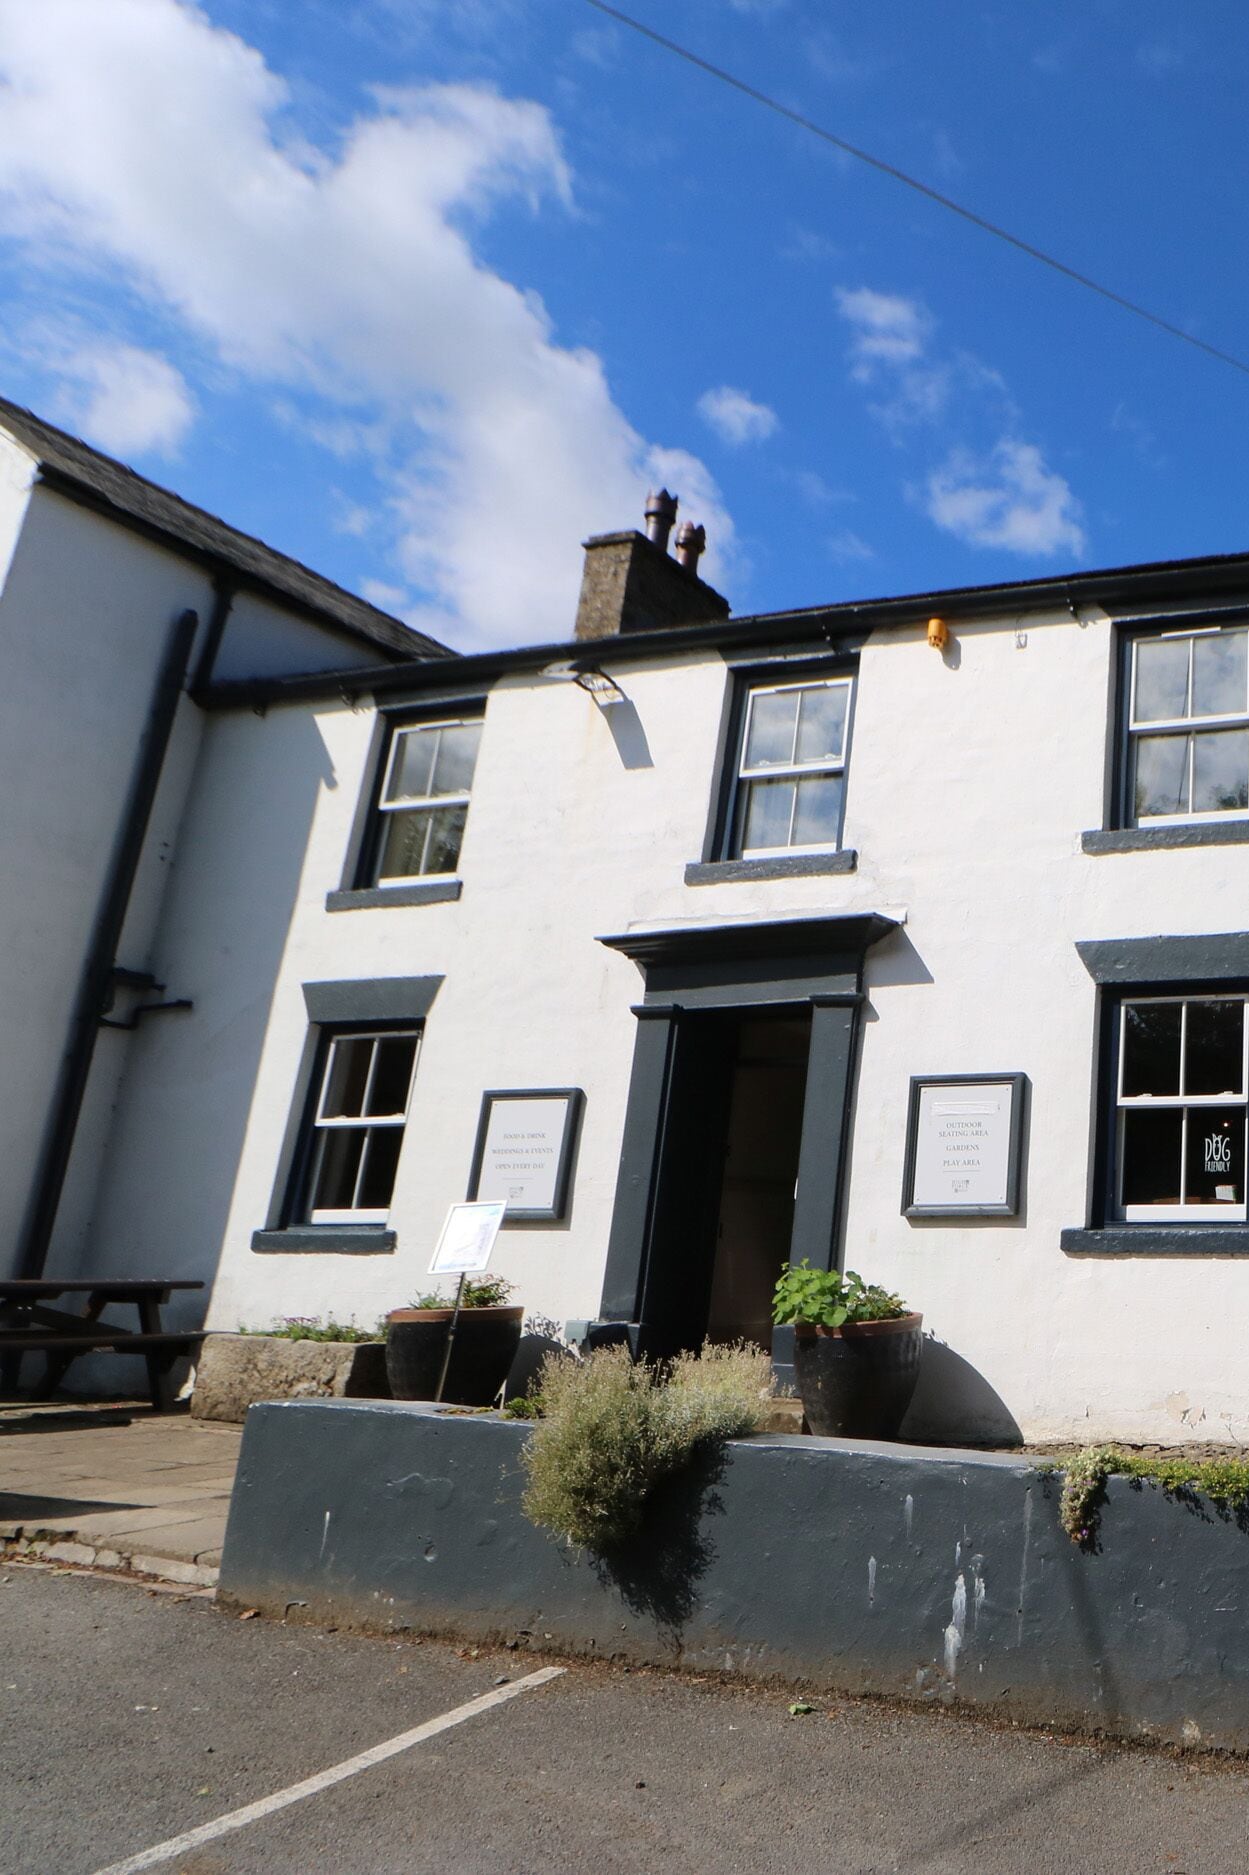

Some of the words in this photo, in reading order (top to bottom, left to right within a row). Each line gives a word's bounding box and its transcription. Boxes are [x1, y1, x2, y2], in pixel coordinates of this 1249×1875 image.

[946, 1121, 982, 1129] OUTDOOR
[970, 1129, 989, 1137] AREA
[1204, 1133, 1231, 1162] DOG
[943, 1159, 961, 1167] PLAY
[1204, 1160, 1231, 1173] FRIENDLY
